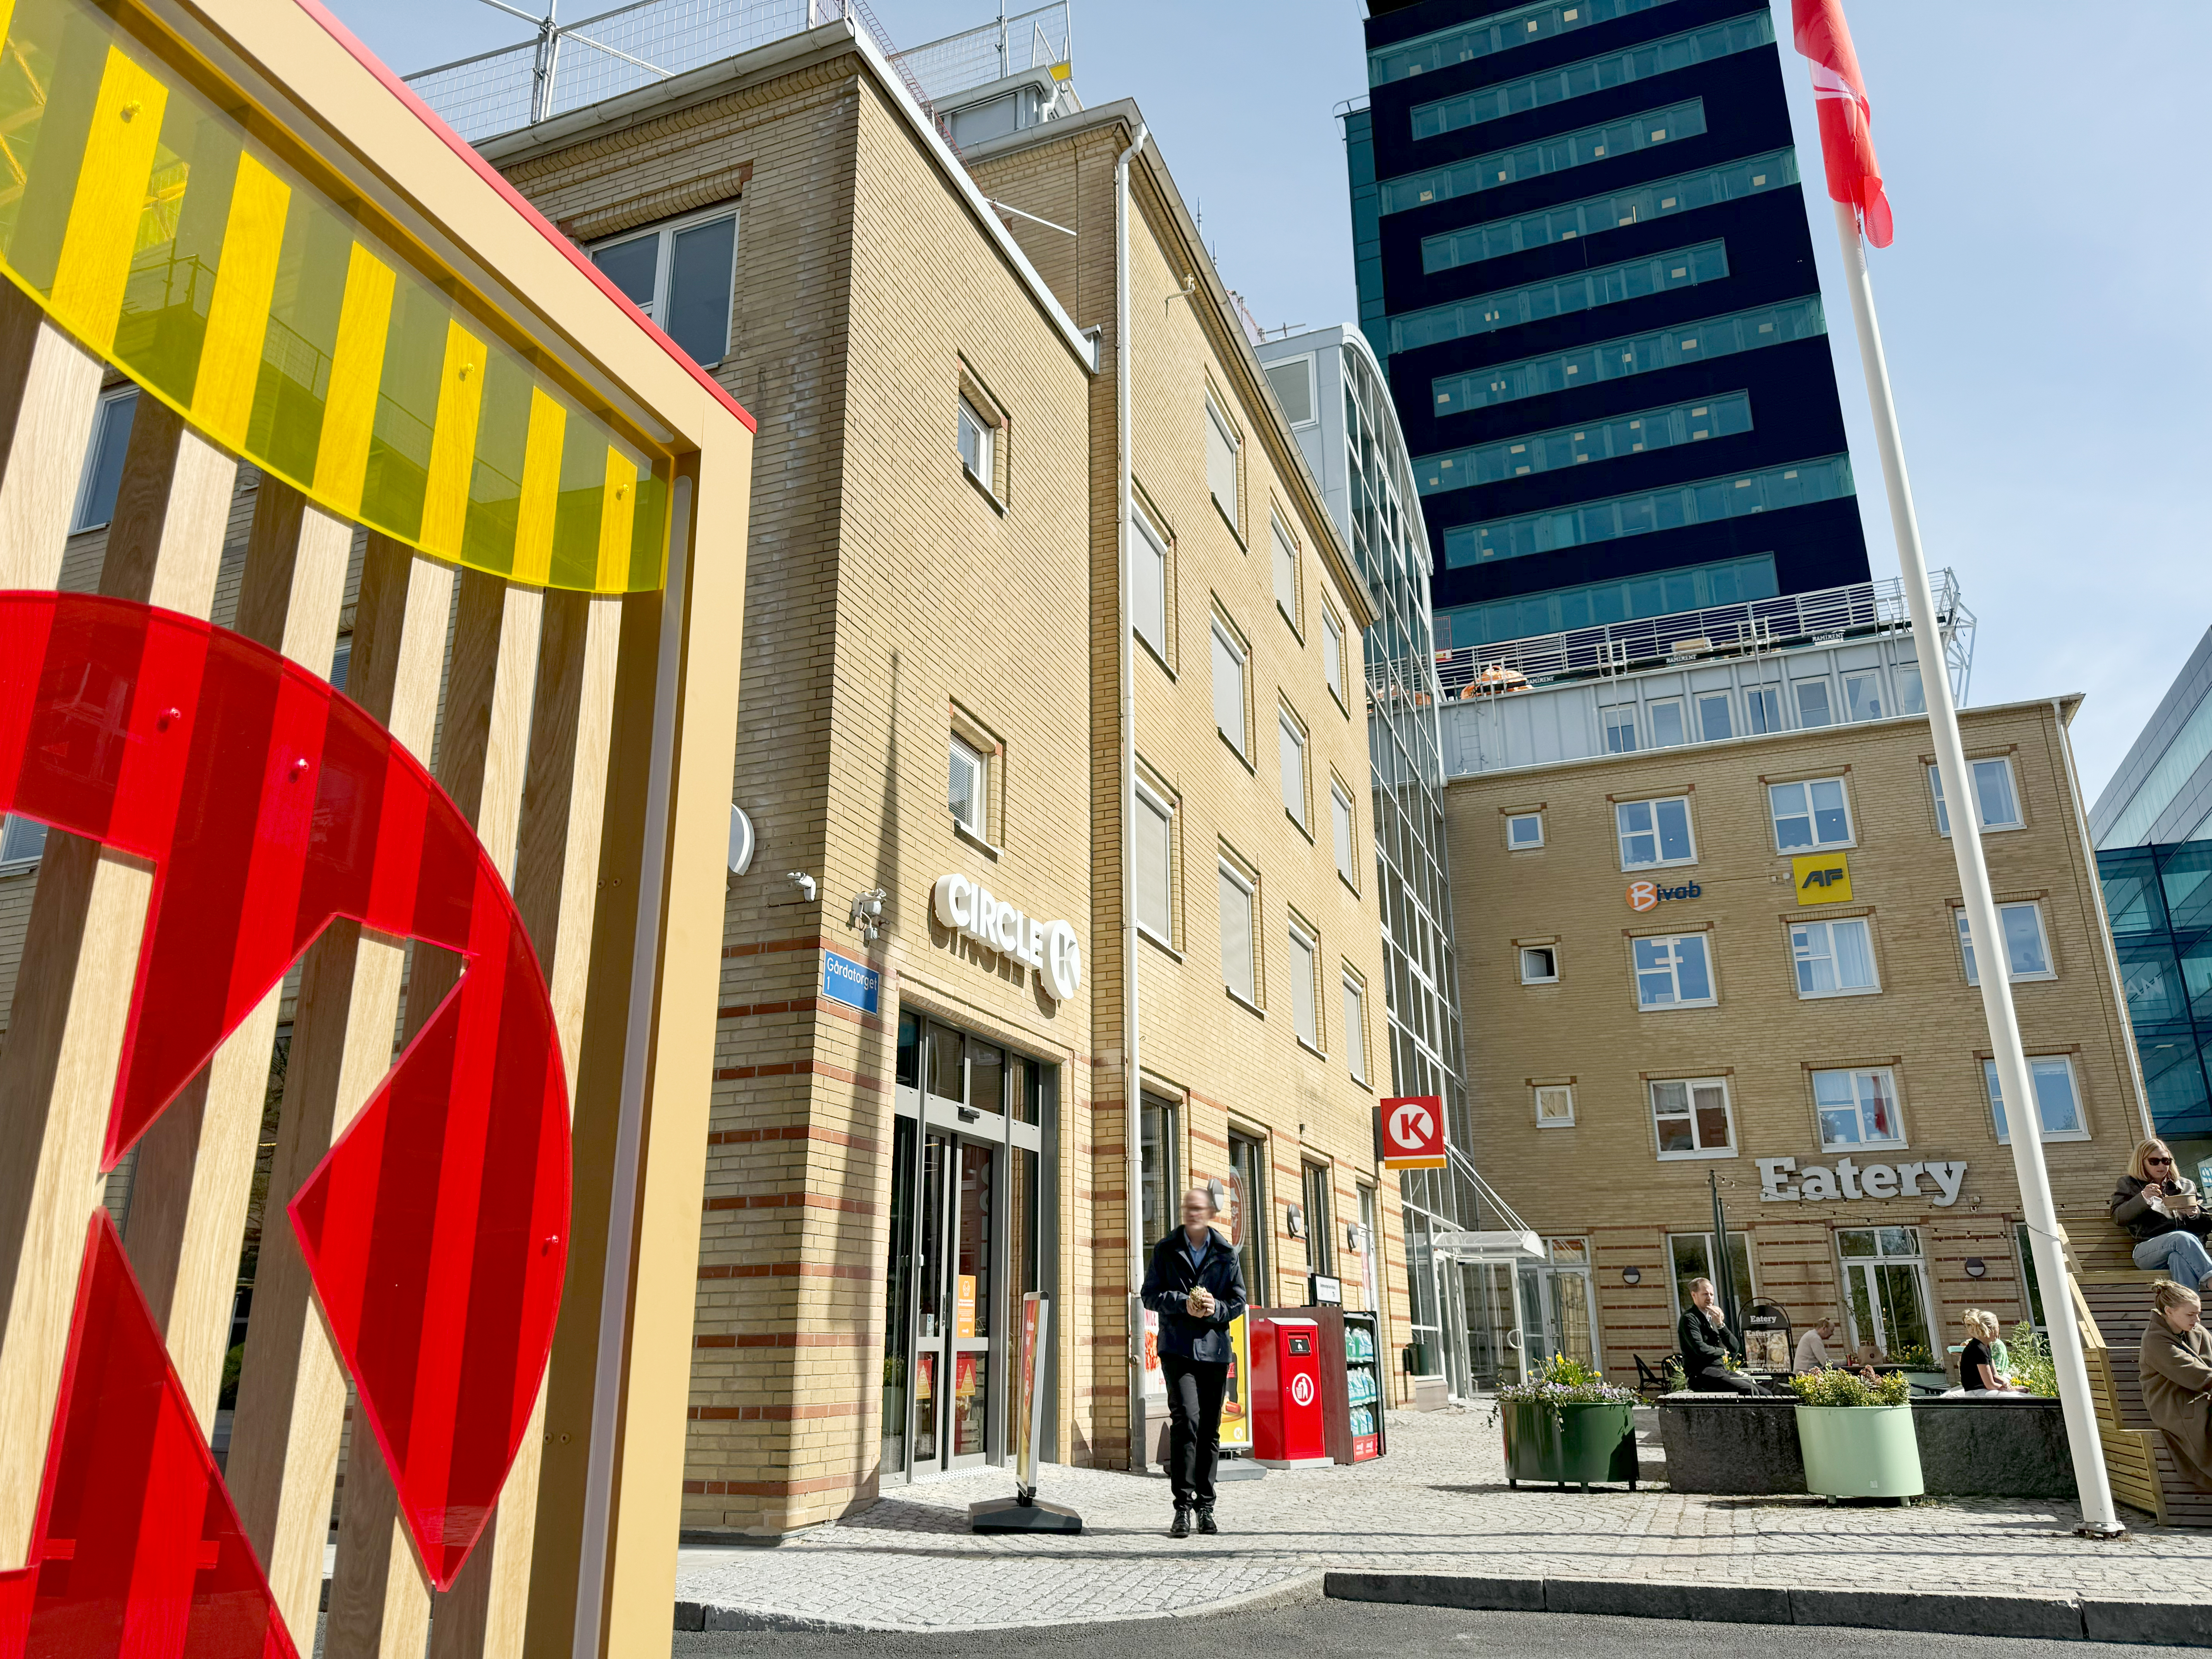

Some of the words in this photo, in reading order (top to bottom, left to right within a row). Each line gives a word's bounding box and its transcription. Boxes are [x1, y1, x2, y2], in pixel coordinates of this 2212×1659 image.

[1812, 632, 1845, 642] RAMIRENT
[1666, 654, 1697, 663] RAMIRENT
[1525, 676, 1555, 685] RAMIRENT
[1802, 868, 1843, 888] AF
[1629, 880, 1701, 911] Bivab
[934, 873, 1044, 969] CIRCLE
[827, 957, 877, 991] Gårdatorget
[827, 976, 830, 990] 1
[1755, 1156, 1968, 1207] Eatery
[1750, 1315, 1777, 1323] Eatery
